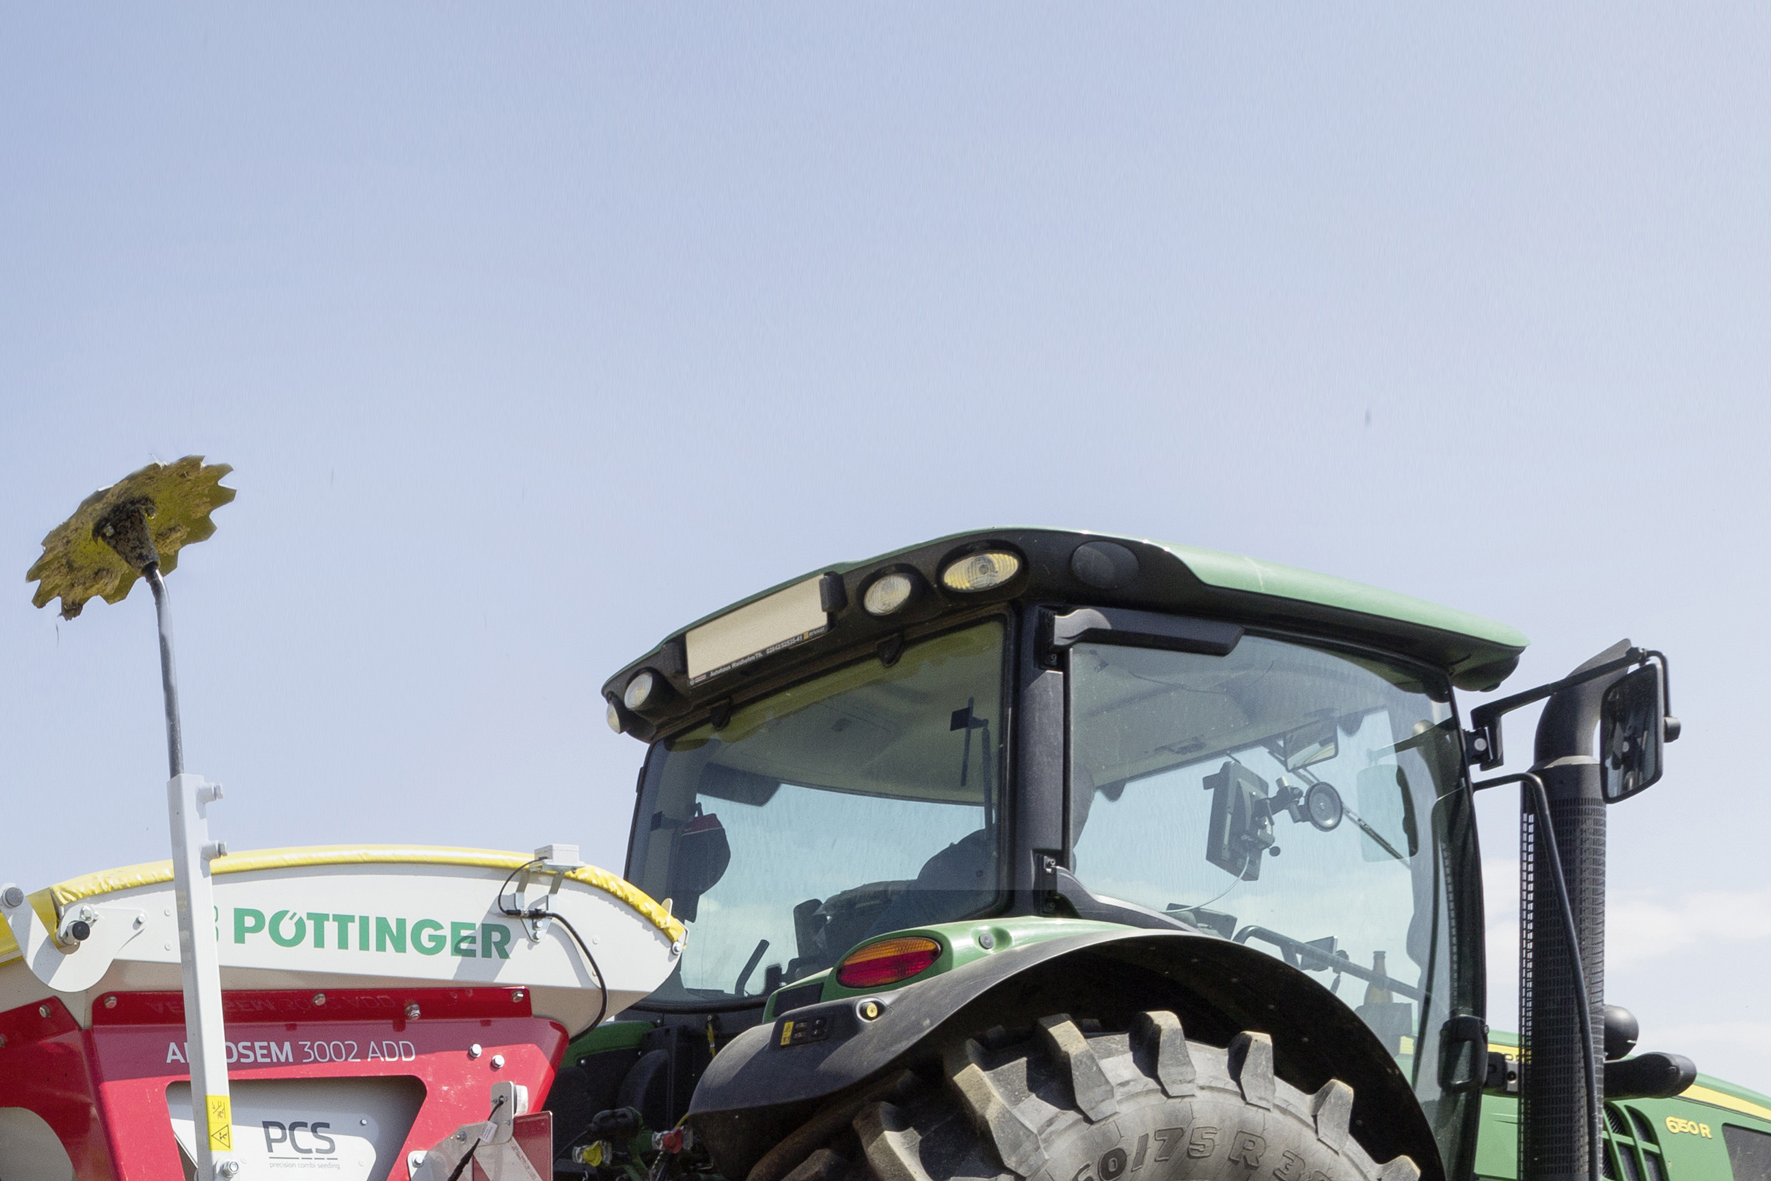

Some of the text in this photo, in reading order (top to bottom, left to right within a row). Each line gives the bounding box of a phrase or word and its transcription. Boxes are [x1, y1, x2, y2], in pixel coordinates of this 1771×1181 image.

[233, 907, 511, 960] PÖTTINGER
[166, 1040, 416, 1064] AOSEM 3002 ADD
[262, 1120, 336, 1154] PCS
[269, 1161, 341, 1170] precision combi seeding
